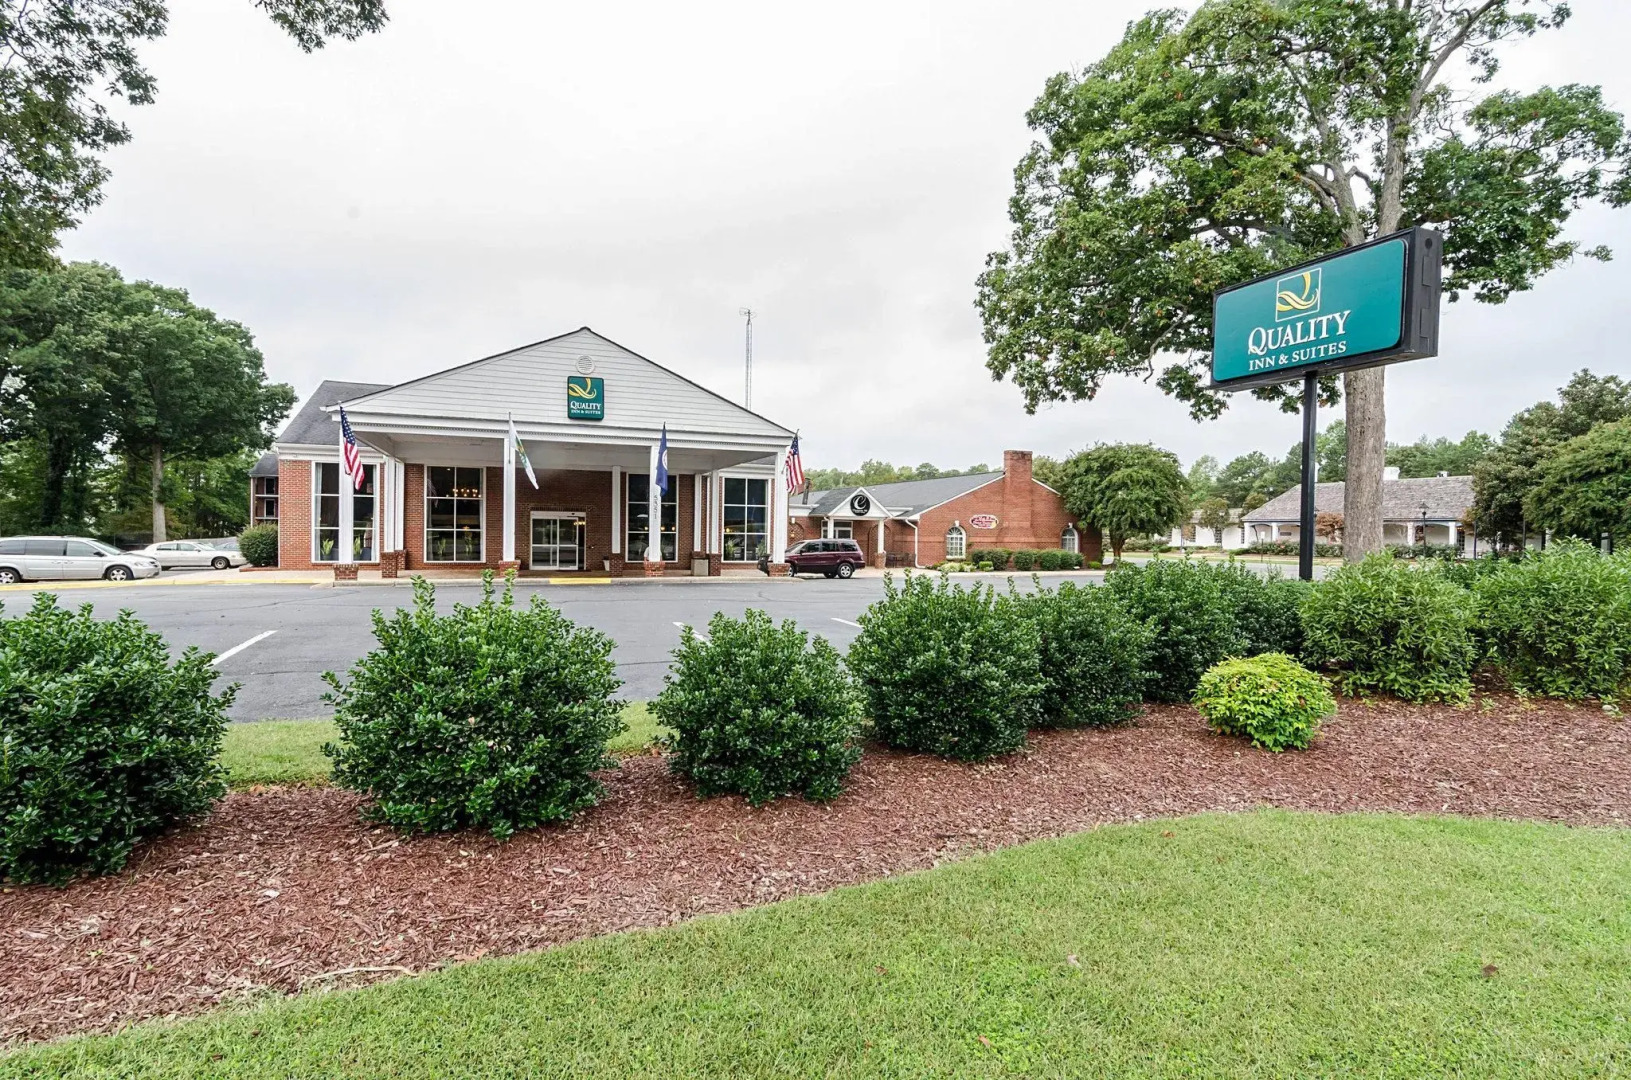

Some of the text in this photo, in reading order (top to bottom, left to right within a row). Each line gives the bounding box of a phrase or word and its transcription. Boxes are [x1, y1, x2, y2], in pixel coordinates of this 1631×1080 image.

[1248, 310, 1351, 355] QUALITY
[1249, 340, 1347, 370] INN & SUITES
[570, 400, 601, 409] QUALITY
